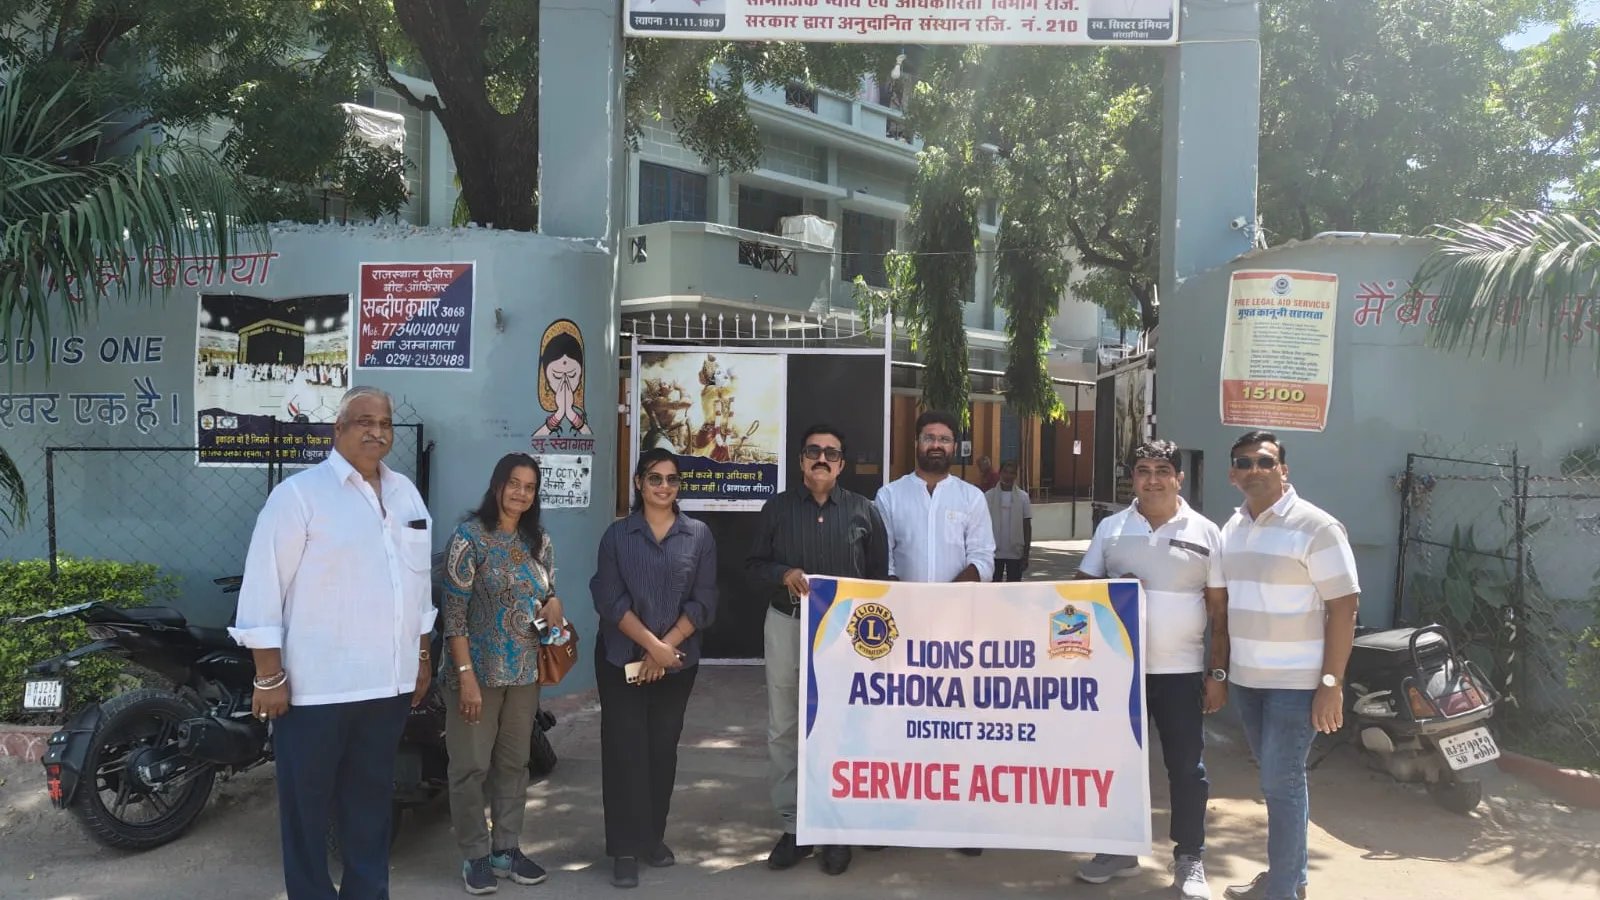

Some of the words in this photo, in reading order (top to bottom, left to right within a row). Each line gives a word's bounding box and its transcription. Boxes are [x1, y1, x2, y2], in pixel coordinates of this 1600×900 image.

[745, 14, 799, 28] सरकार
[802, 16, 835, 29] द्वारा
[838, 14, 914, 34] अनुदानित
[918, 14, 972, 31] संस्थान
[975, 15, 1012, 32] रजि.
[371, 269, 420, 280] राजस्थान
[422, 267, 454, 281] पुलिस
[362, 293, 407, 319] सन्दीप
[405, 298, 441, 321] कुमार
[440, 306, 465, 318] 3068
[1234, 298, 1250, 307] FREE
[1251, 298, 1275, 306] LEGAL
[1277, 298, 1291, 306] AID
[1294, 298, 1330, 309] SERVICES
[1353, 280, 1395, 326] मैं
[1256, 307, 1287, 319] कानूनी
[1288, 309, 1323, 320] सहायता
[381, 322, 460, 337] 7734040044
[51, 336, 84, 364] IS
[99, 335, 164, 364] ONE
[371, 340, 397, 350] थाना
[364, 353, 380, 365] Ph.
[1242, 386, 1306, 403] 15100
[69, 393, 128, 426] एक
[555, 468, 578, 478] CCTV
[695, 468, 713, 479] करने
[725, 469, 756, 480] अधिकार
[757, 470, 763, 481] है
[752, 482, 775, 494] गीता)
[857, 604, 890, 618] LIONS
[866, 619, 881, 640] L
[906, 639, 974, 669] LIONS
[979, 639, 1036, 669] CLUB
[848, 672, 966, 708] ASHOKA
[973, 676, 1100, 711] UDAIPUR
[906, 719, 973, 740] DISTRICT
[976, 722, 1014, 741] 3233
[1018, 723, 1036, 742] E2
[831, 760, 960, 801] SERVICE
[968, 764, 1114, 808] ACTIVITY
